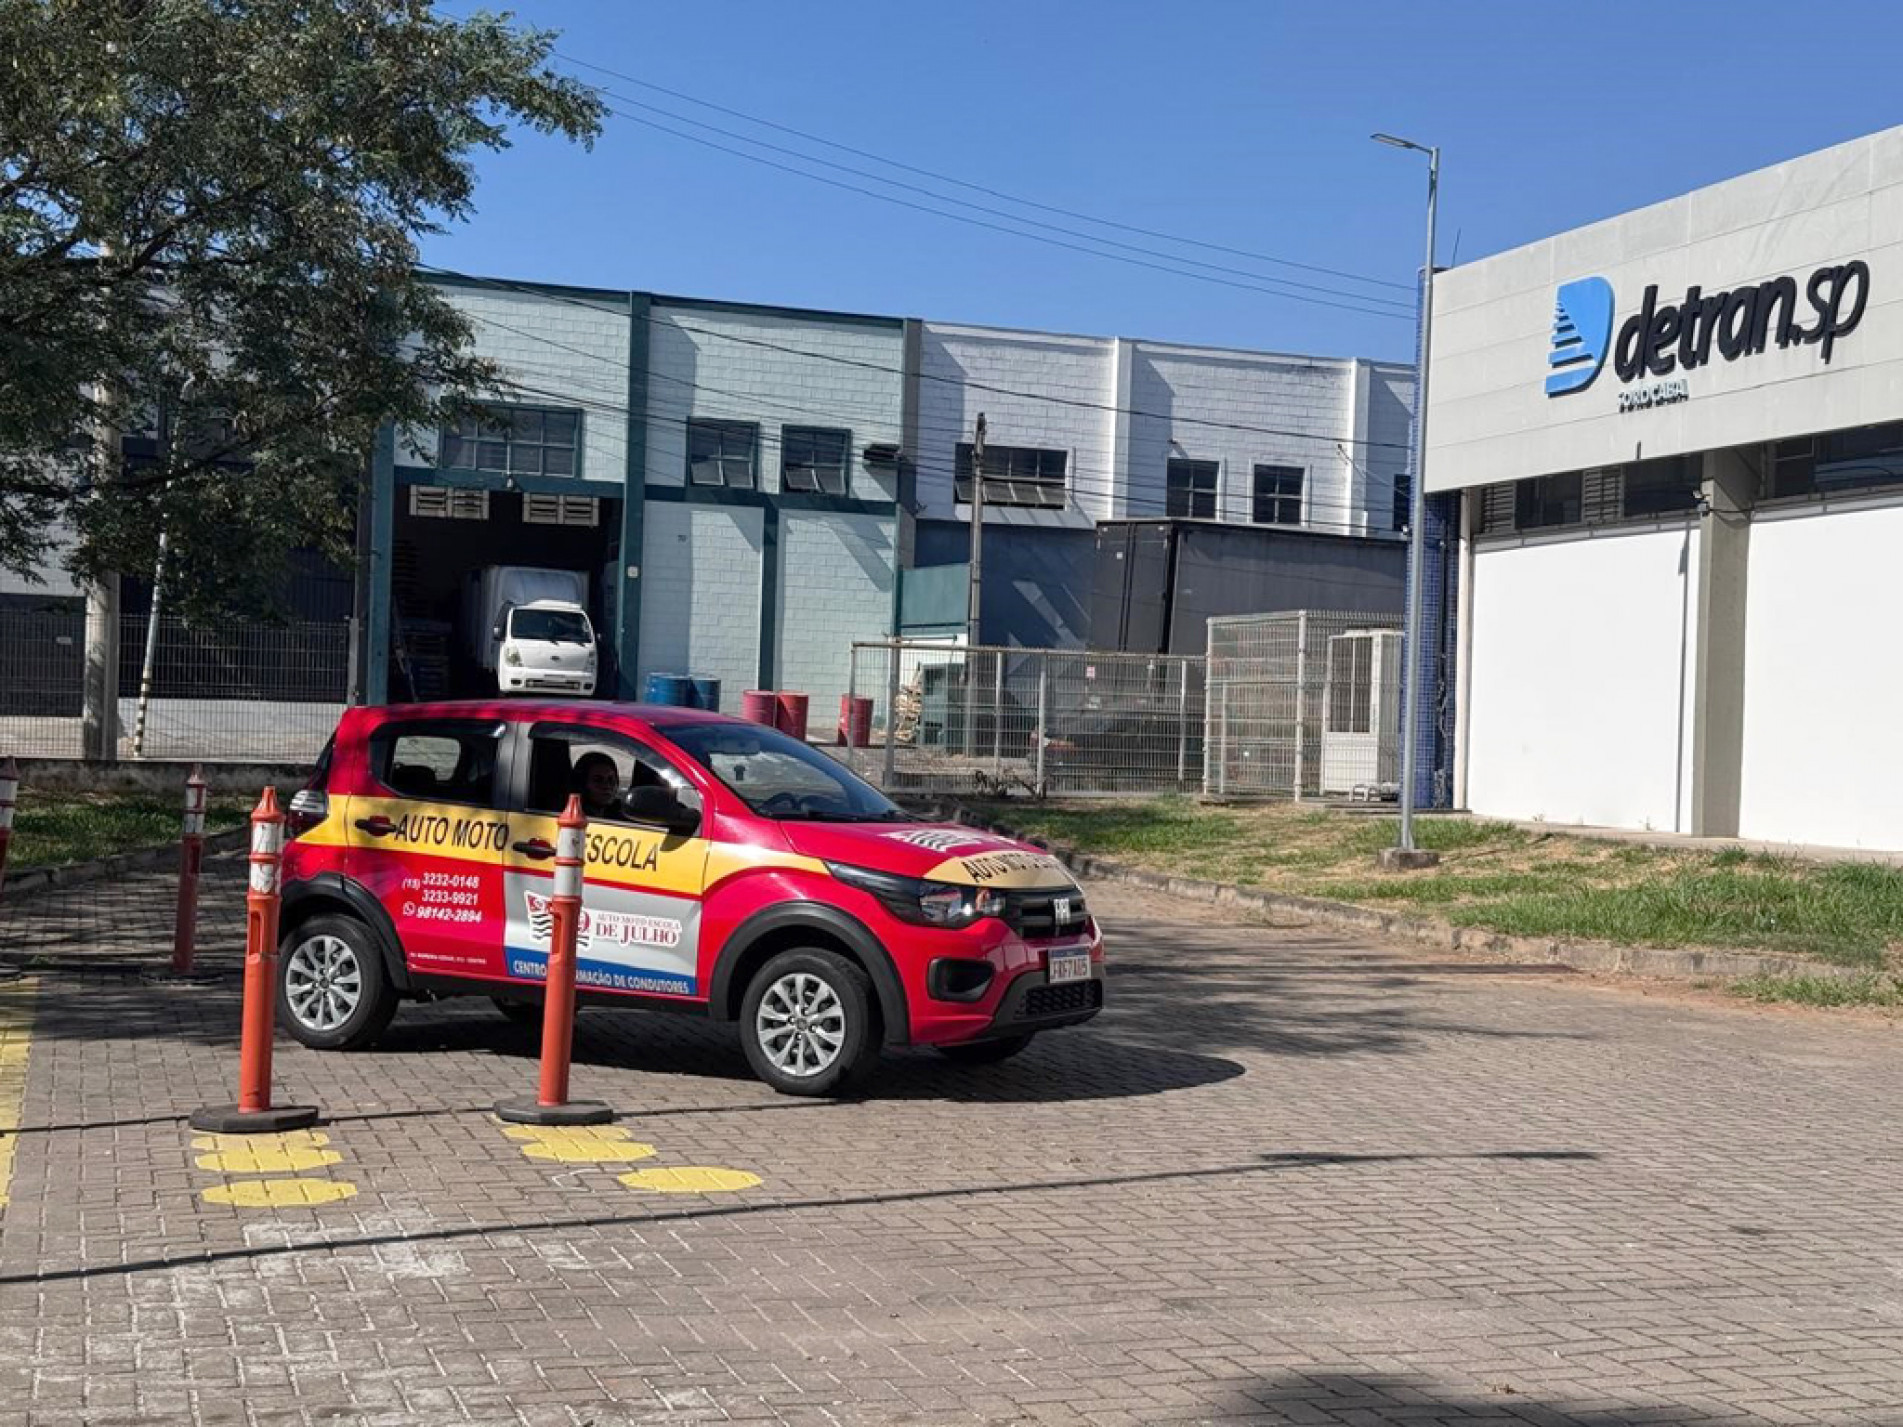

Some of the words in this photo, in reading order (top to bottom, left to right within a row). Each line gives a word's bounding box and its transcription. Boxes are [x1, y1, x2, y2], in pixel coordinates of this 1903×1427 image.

[1615, 260, 1870, 383] detran.sp
[394, 813, 449, 845] AUTO
[451, 819, 509, 851] MOTO
[595, 922, 618, 937] DE
[620, 925, 679, 944] JULHO
[513, 960, 547, 977] CENTRO
[614, 974, 627, 988] DE
[628, 975, 690, 994] CONDUTORES
